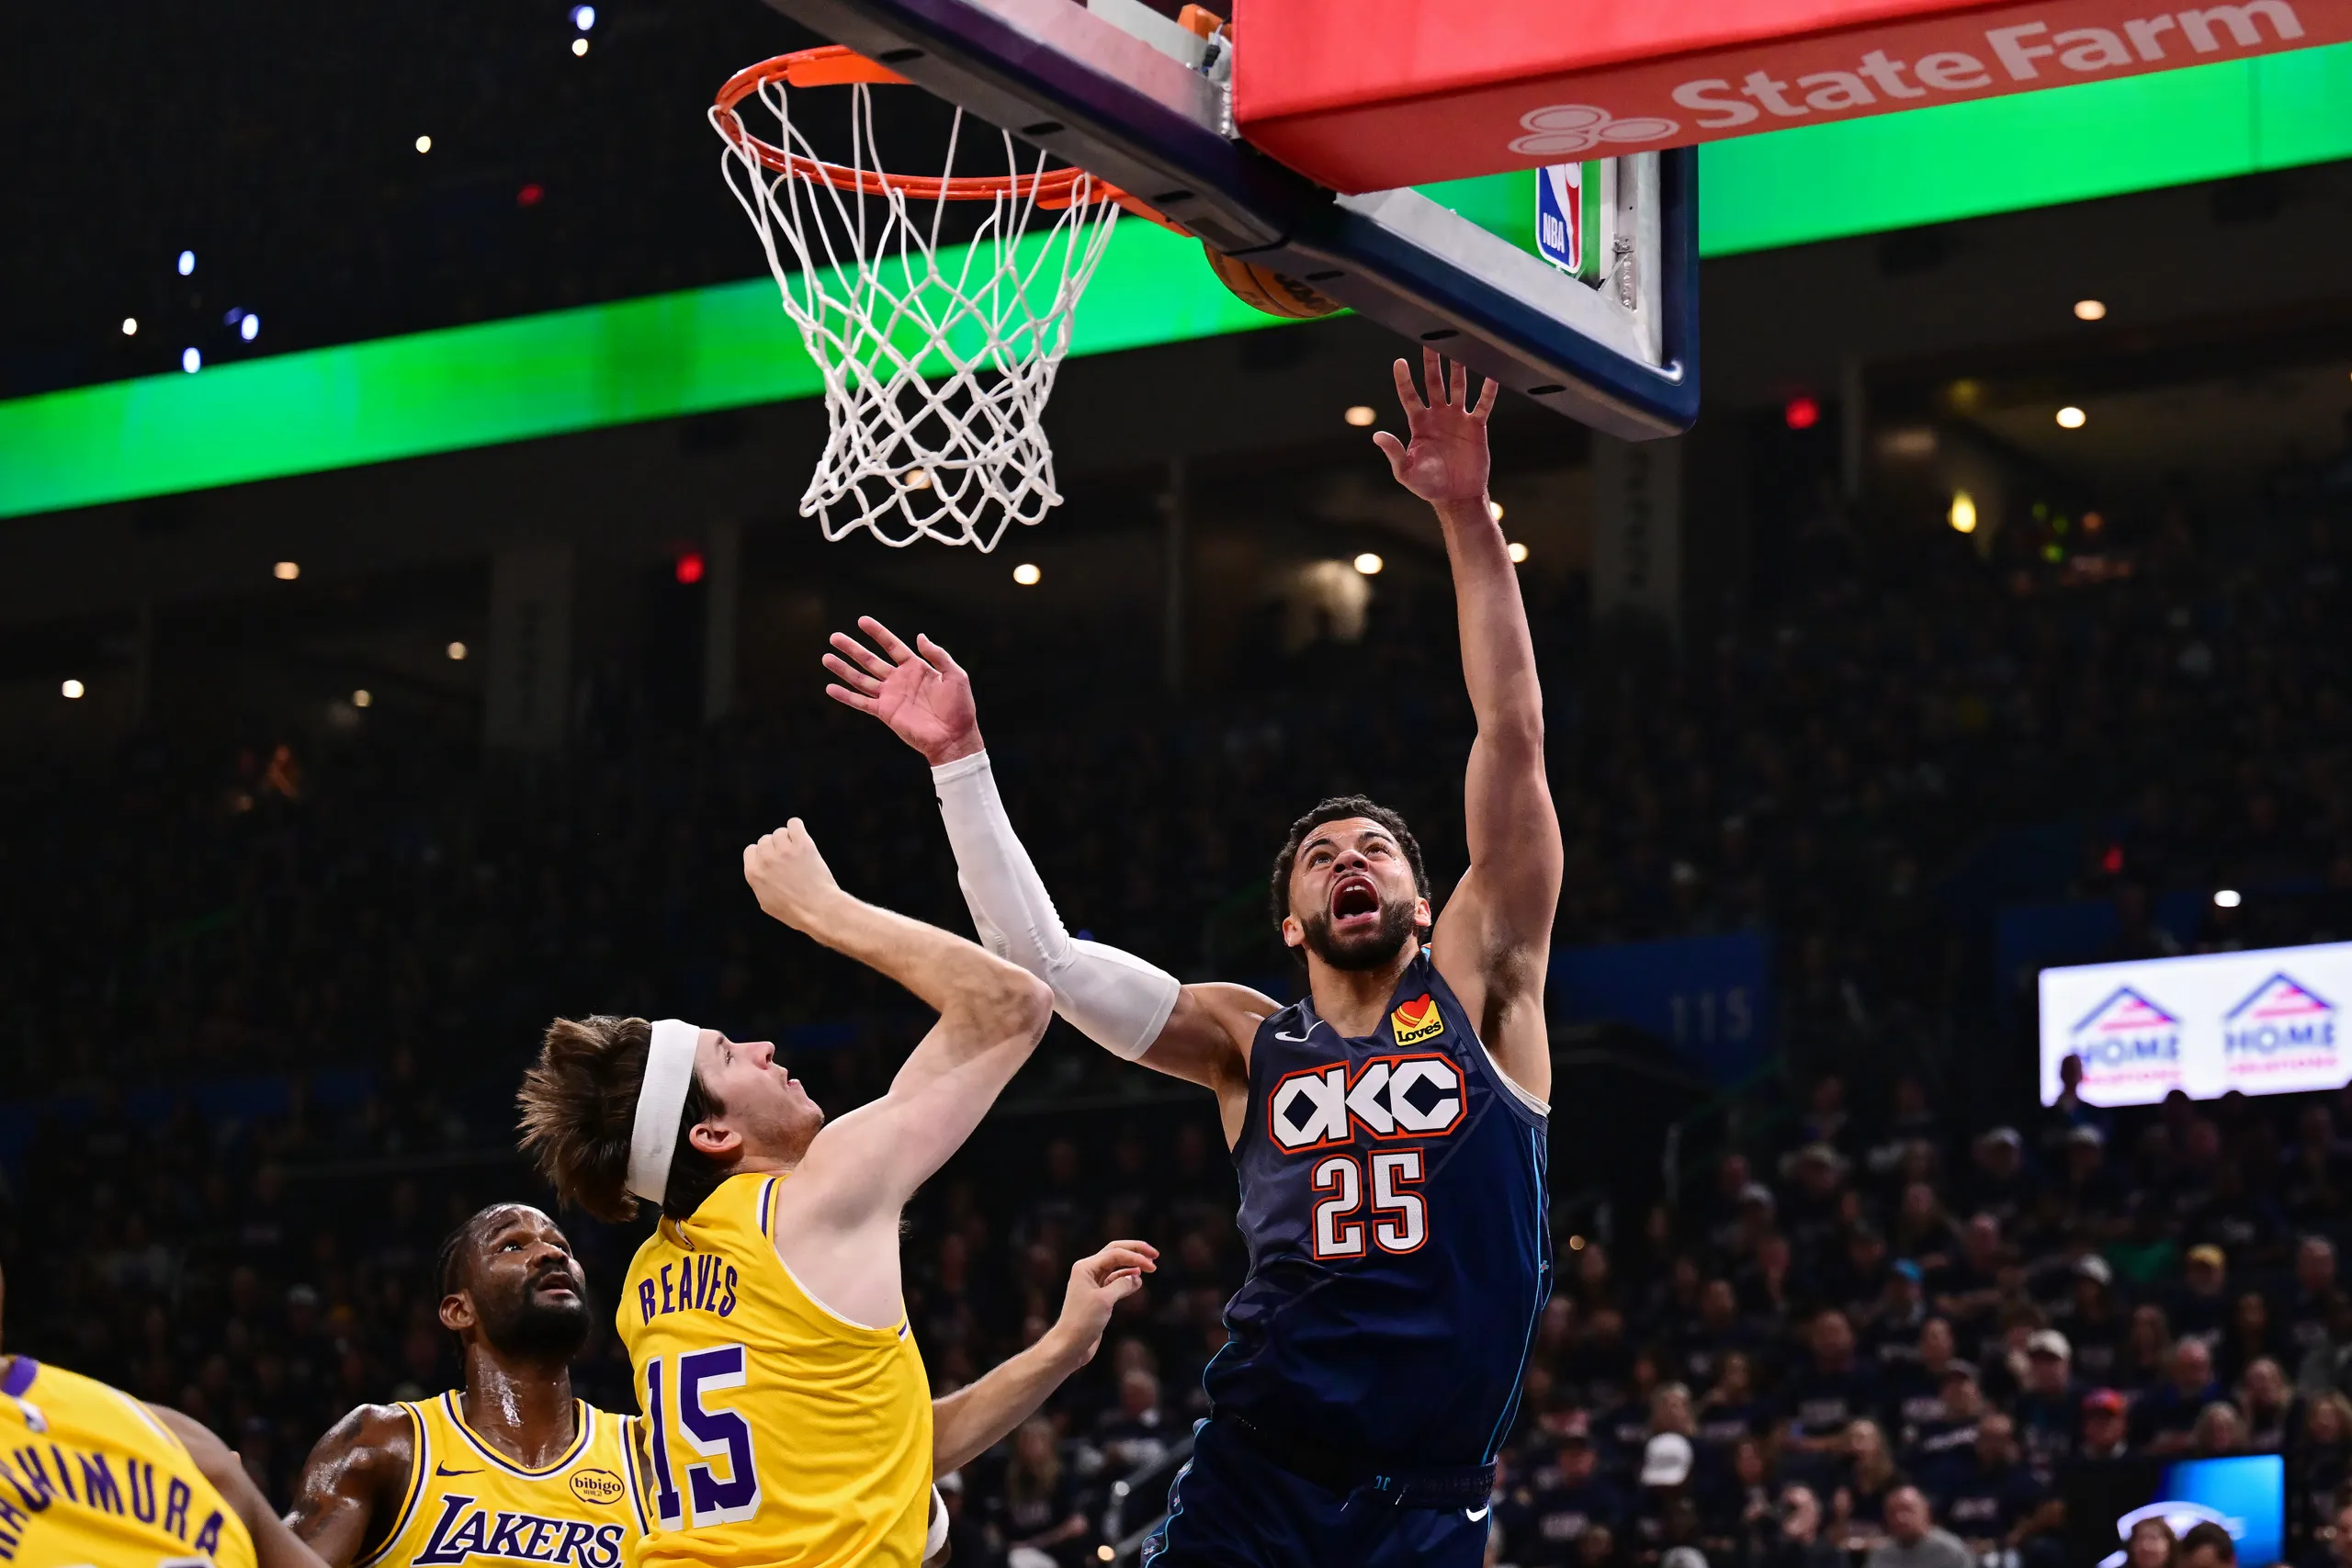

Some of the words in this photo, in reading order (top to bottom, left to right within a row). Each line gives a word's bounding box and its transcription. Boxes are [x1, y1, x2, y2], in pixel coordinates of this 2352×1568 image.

[1543, 212, 1566, 254] NBA
[1268, 1053, 1468, 1155] OKC
[1312, 1148, 1429, 1260] 25
[639, 1255, 738, 1325] REAVES
[647, 1343, 763, 1532] 15
[575, 1477, 621, 1495] bibigo
[410, 1494, 628, 1568] LAKERS
